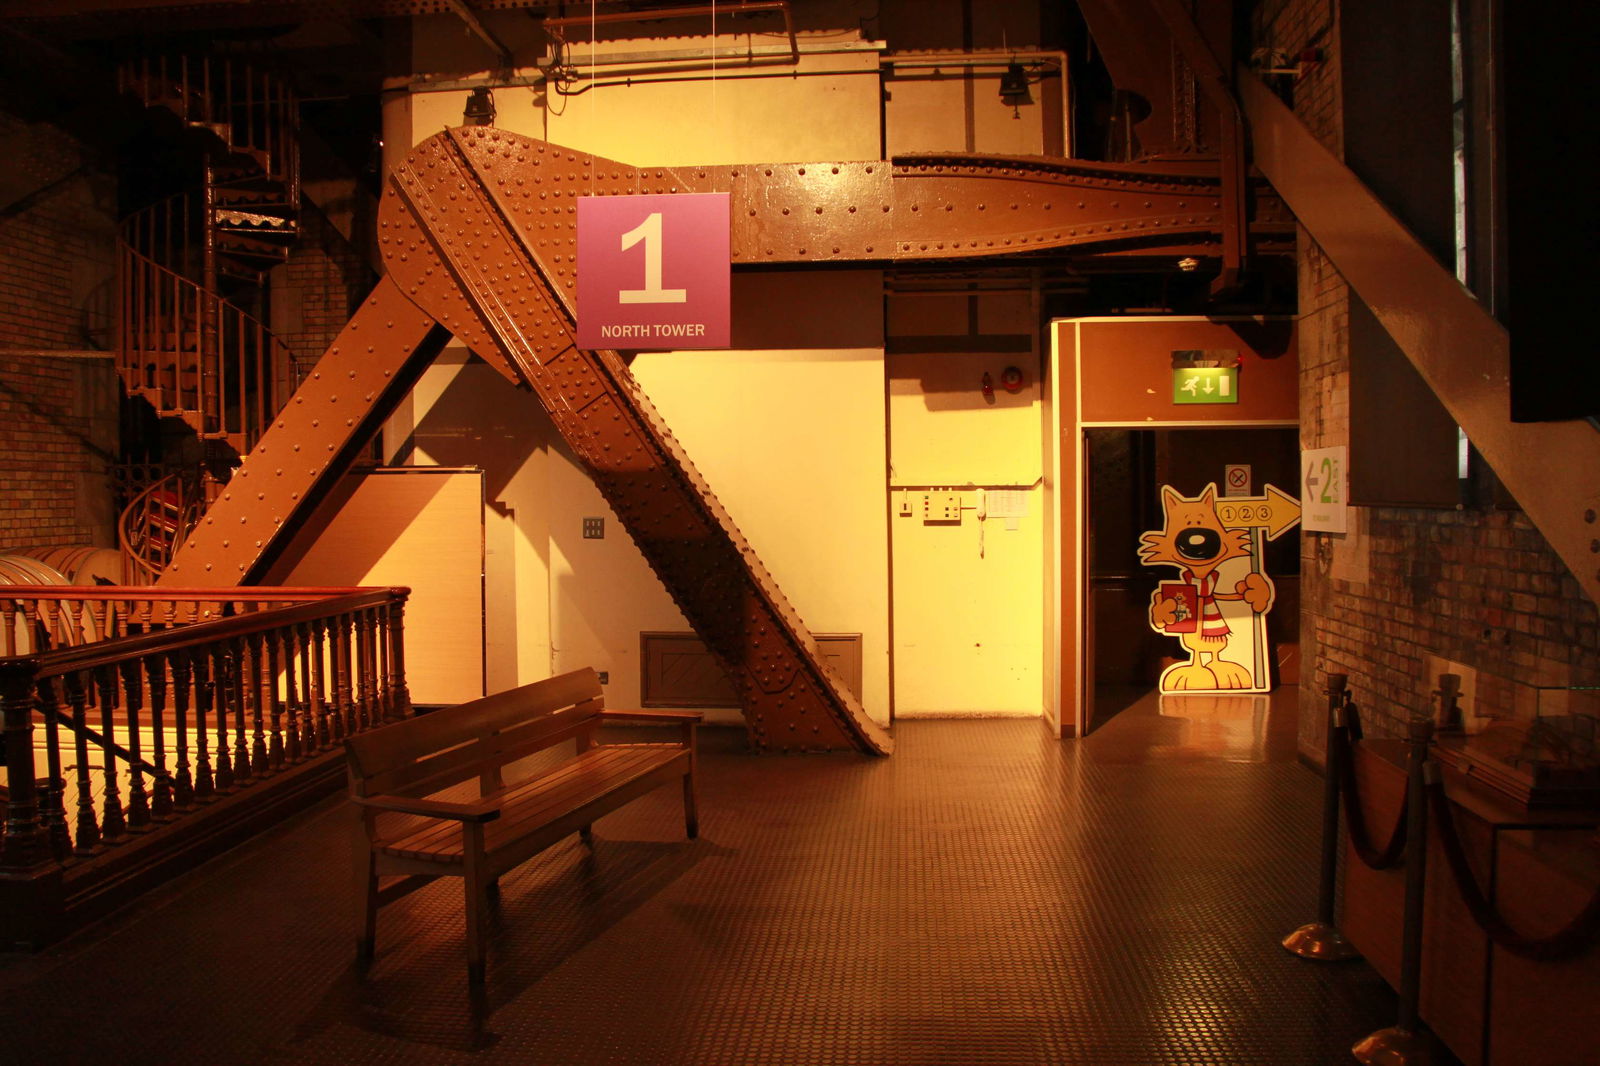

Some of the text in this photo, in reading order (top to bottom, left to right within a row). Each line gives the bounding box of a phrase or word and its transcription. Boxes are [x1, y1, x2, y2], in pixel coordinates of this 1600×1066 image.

[619, 213, 687, 304] 1
[601, 324, 705, 338] NORTH TOWER
[1320, 457, 1332, 503] 2
